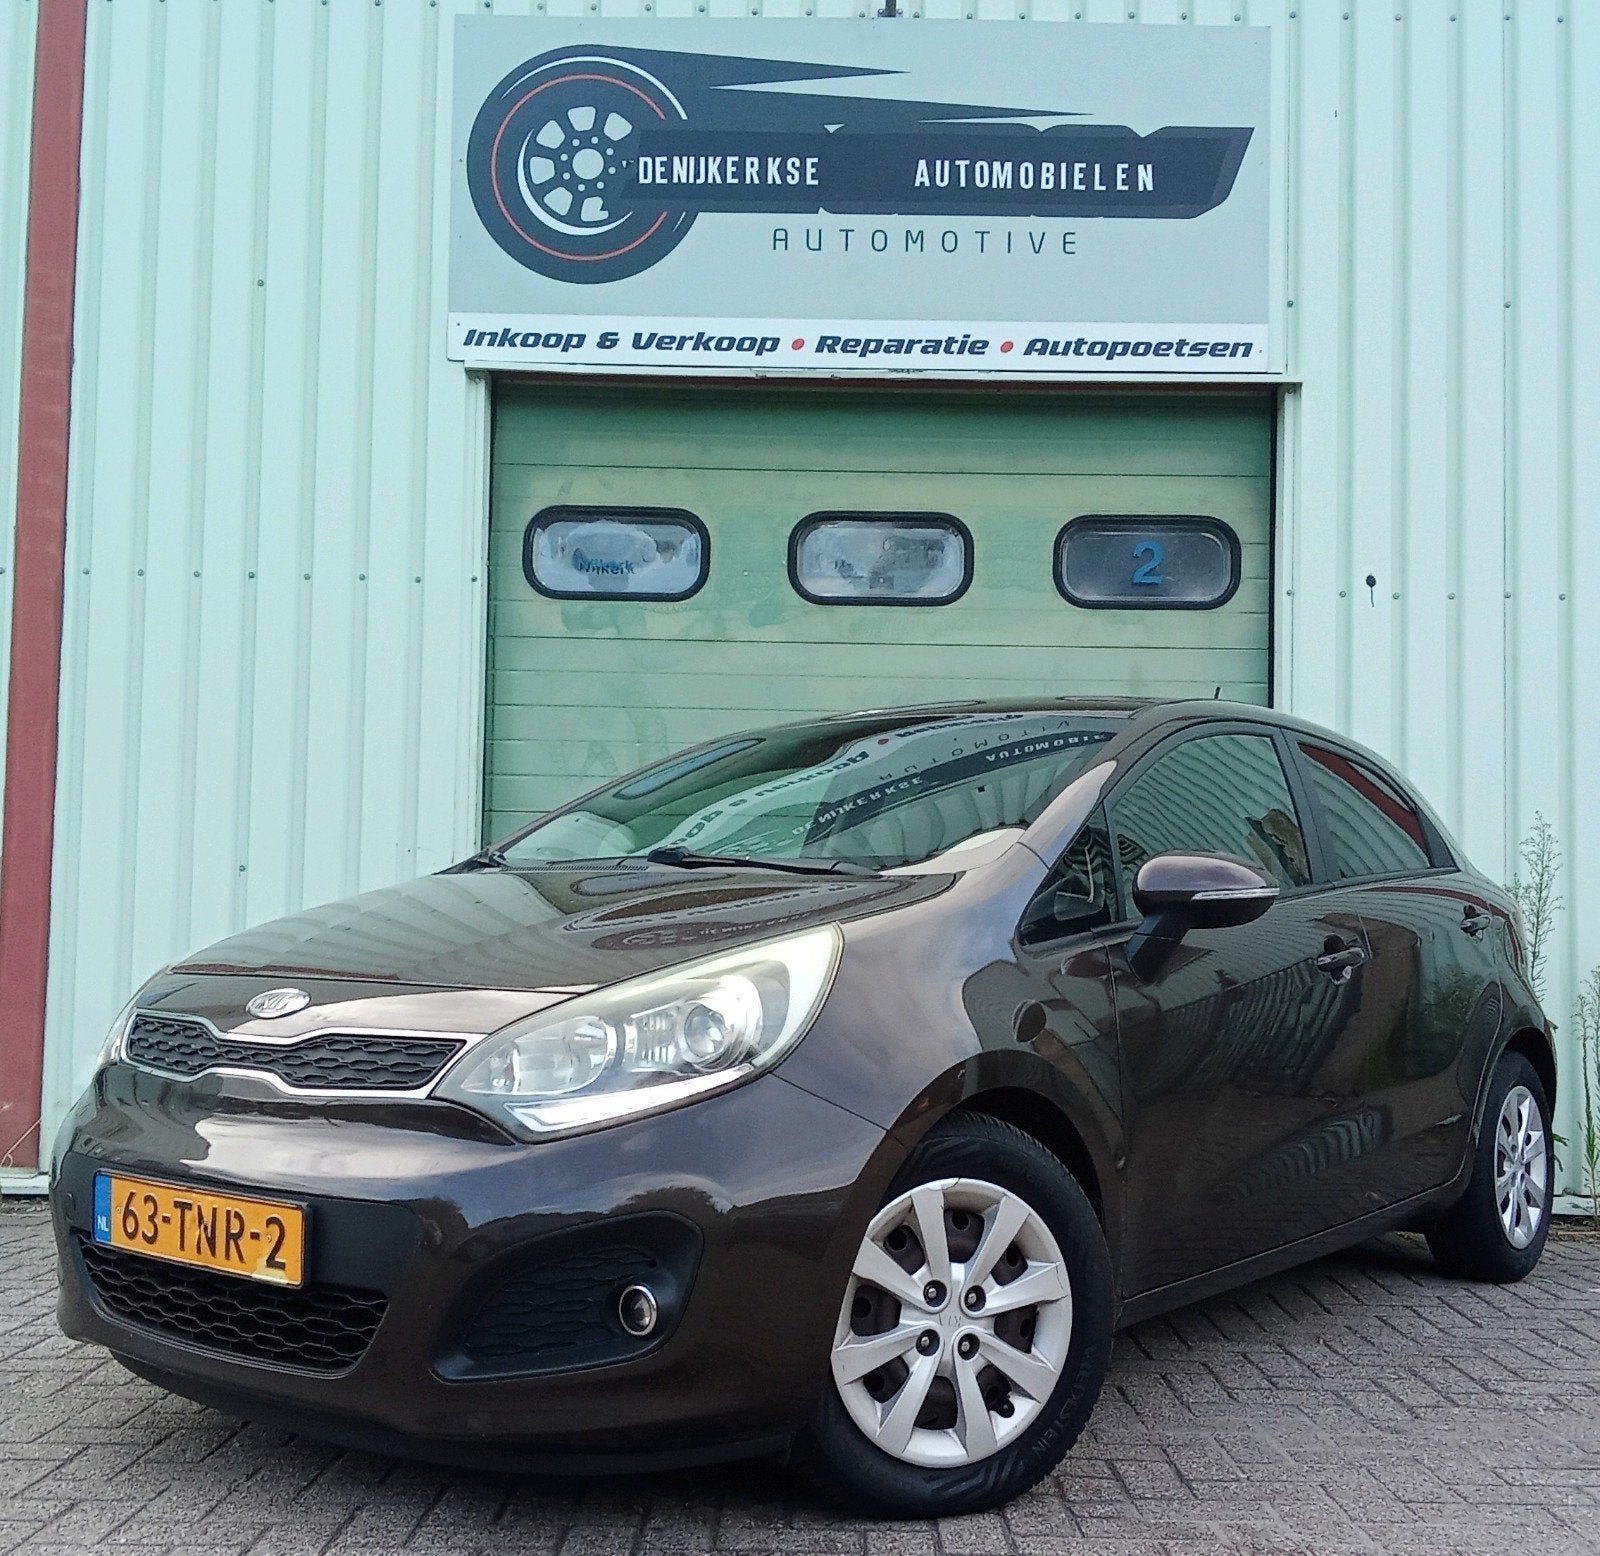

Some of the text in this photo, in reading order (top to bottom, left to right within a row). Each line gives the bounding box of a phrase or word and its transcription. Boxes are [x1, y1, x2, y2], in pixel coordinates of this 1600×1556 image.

[914, 159, 1154, 191] AUTOMOBIELEN
[772, 228, 1076, 255] AUTOMOTIVE
[463, 328, 1252, 360] Inkoop & Verkoop Reparatie Autopoetsen
[1133, 541, 1163, 585] 2
[97, 1190, 287, 1270] NL 63-TNR-2
